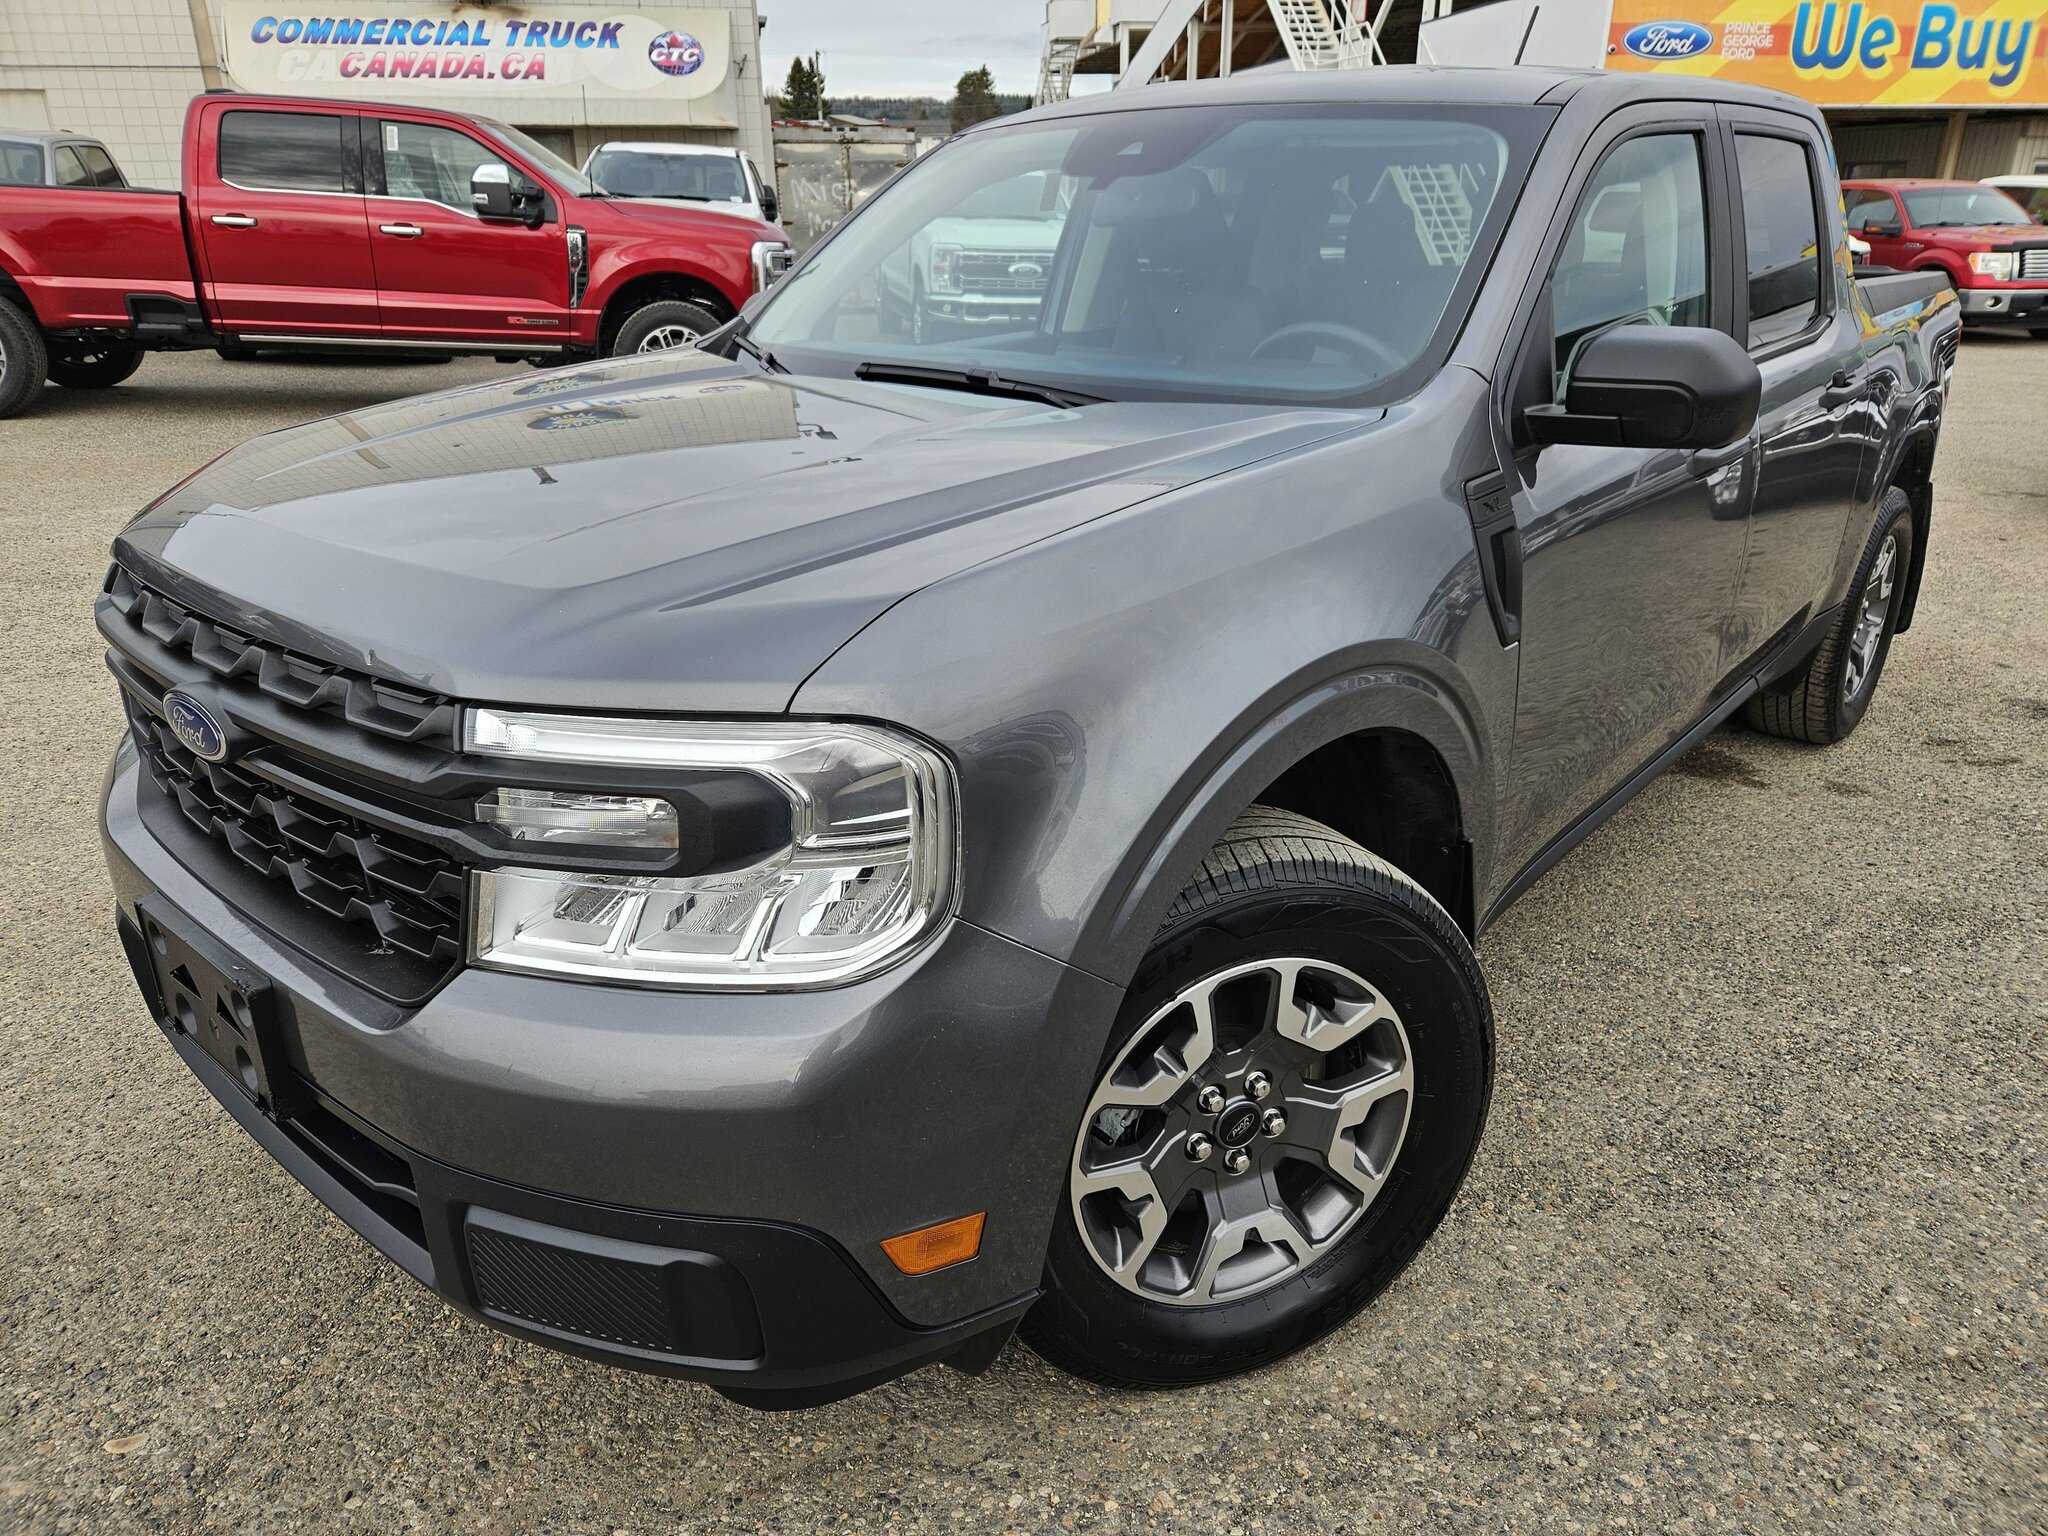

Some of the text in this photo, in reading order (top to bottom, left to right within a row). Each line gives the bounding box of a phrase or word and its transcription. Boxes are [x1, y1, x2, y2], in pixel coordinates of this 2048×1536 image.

[251, 16, 625, 48] COMMERCIAL TRUCK
[1639, 24, 1697, 55] Ford
[1722, 34, 1774, 48] GEORGE
[1725, 22, 1771, 34] PRINCE
[650, 48, 700, 62] CTC
[1721, 48, 1756, 60] FORD
[1792, 2, 2035, 87] We Buy
[339, 51, 546, 80] CANADA.CA
[172, 705, 206, 749] Ford
